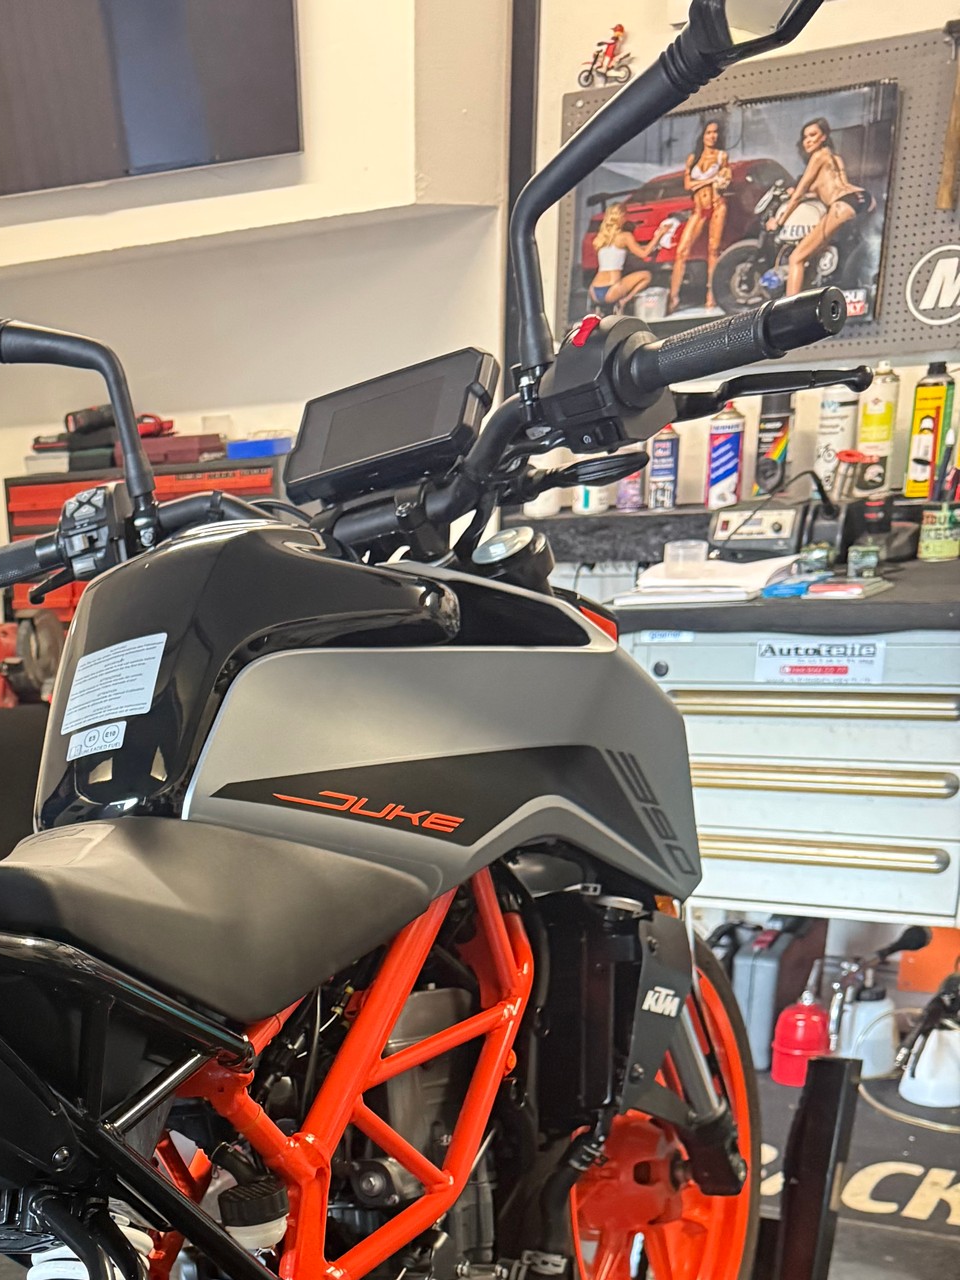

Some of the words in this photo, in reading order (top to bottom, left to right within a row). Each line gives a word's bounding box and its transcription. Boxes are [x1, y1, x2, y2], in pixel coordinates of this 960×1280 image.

[272, 790, 465, 834] DUKE
[604, 747, 699, 876] 390
[641, 985, 681, 1018] KTM
